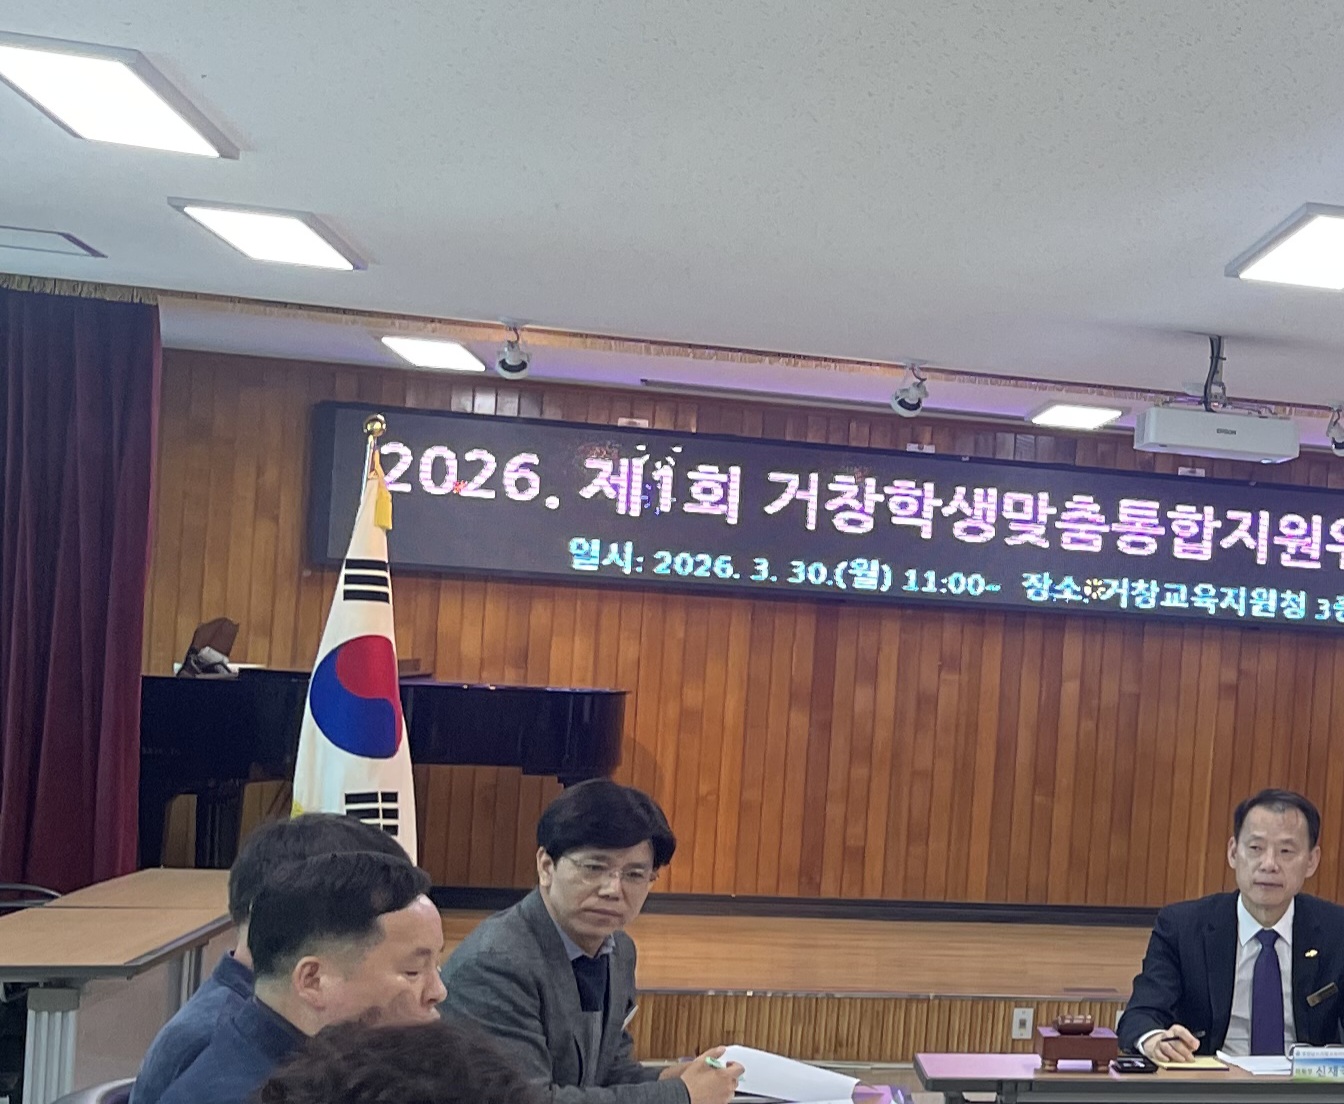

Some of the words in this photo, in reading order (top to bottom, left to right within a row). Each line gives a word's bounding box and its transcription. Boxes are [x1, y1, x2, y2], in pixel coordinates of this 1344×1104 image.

[380, 441, 560, 510] 2026.
[578, 456, 742, 525] 제1회
[568, 536, 644, 575] 일시:
[652, 550, 741, 579] 2026.
[750, 558, 778, 583] 3.
[787, 557, 892, 592] 30.(월)
[1101, 577, 1307, 620] 거창교육지원청
